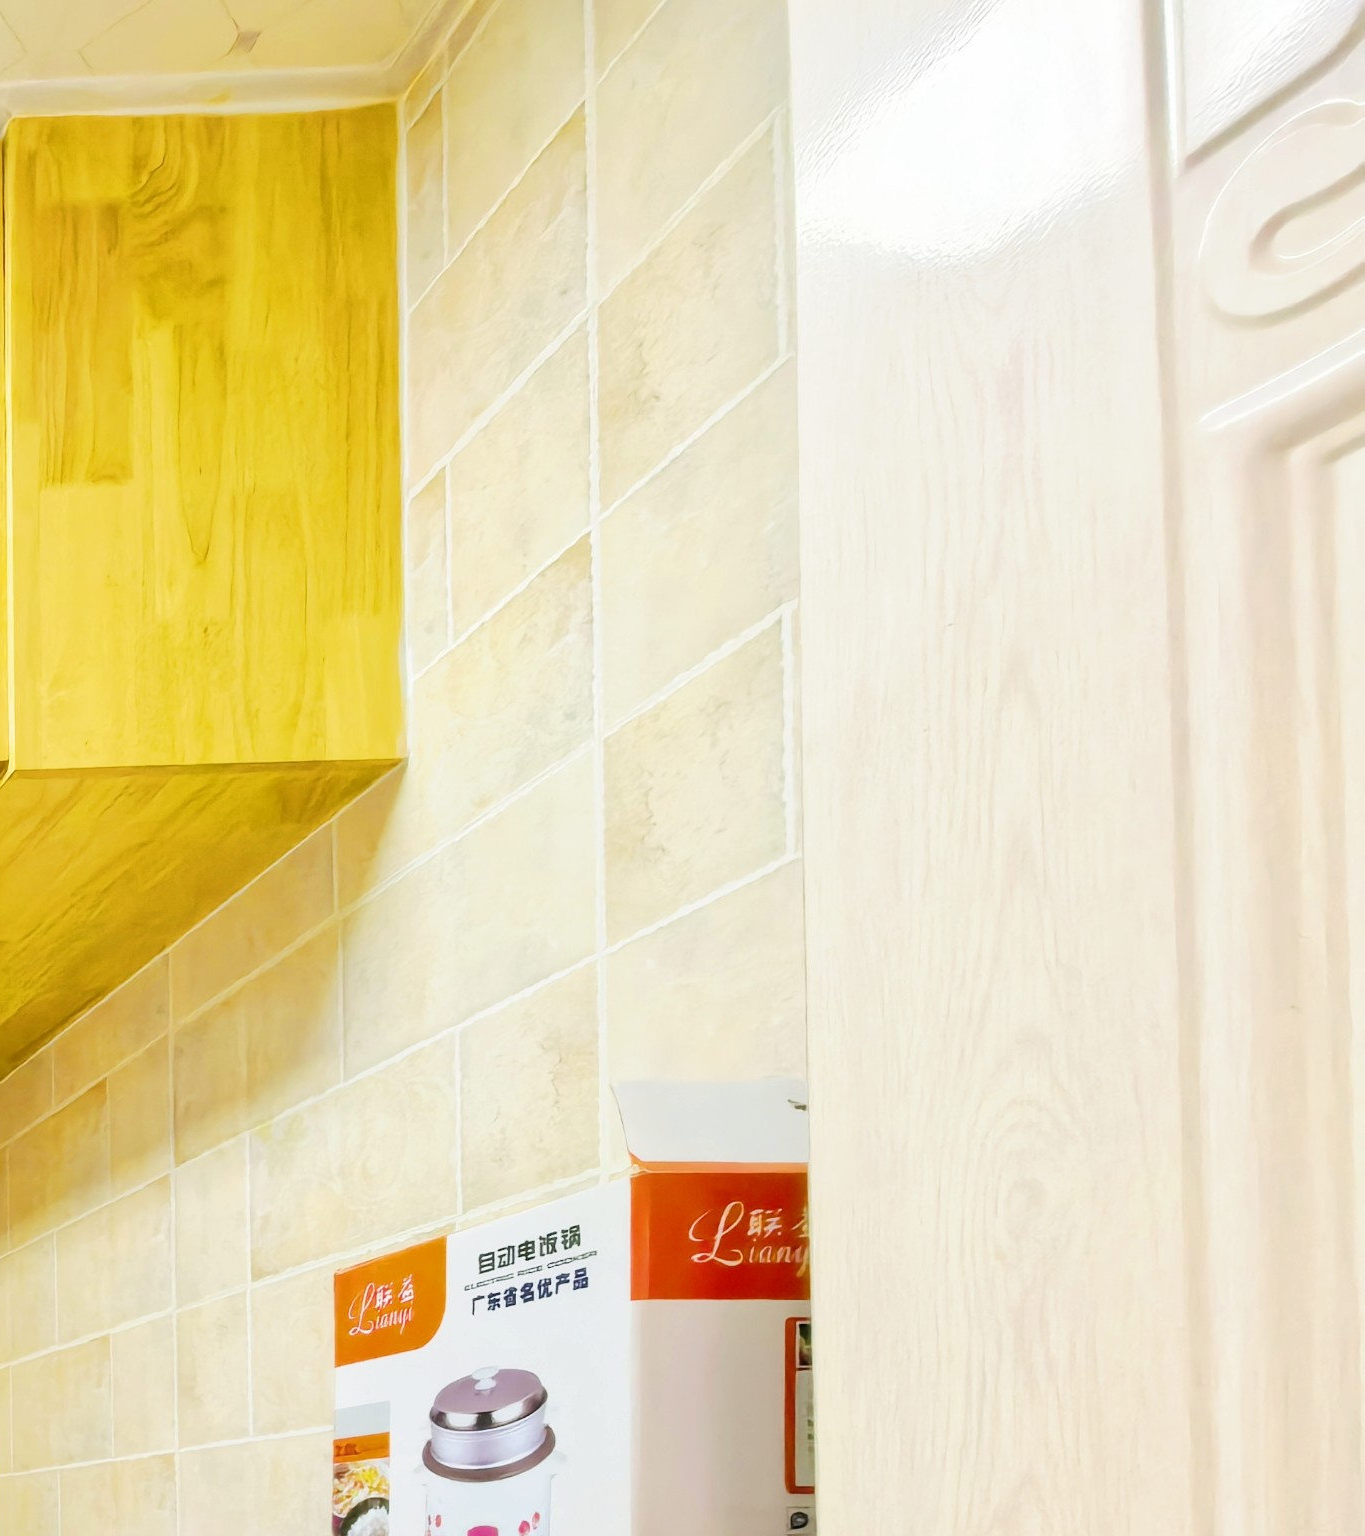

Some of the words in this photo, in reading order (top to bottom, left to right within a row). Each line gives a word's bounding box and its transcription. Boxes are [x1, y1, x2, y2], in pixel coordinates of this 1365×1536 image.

[478, 1225, 581, 1274] 自动电饭锅
[689, 1201, 809, 1277] Liany
[472, 1267, 589, 1315] 广东省名优产品
